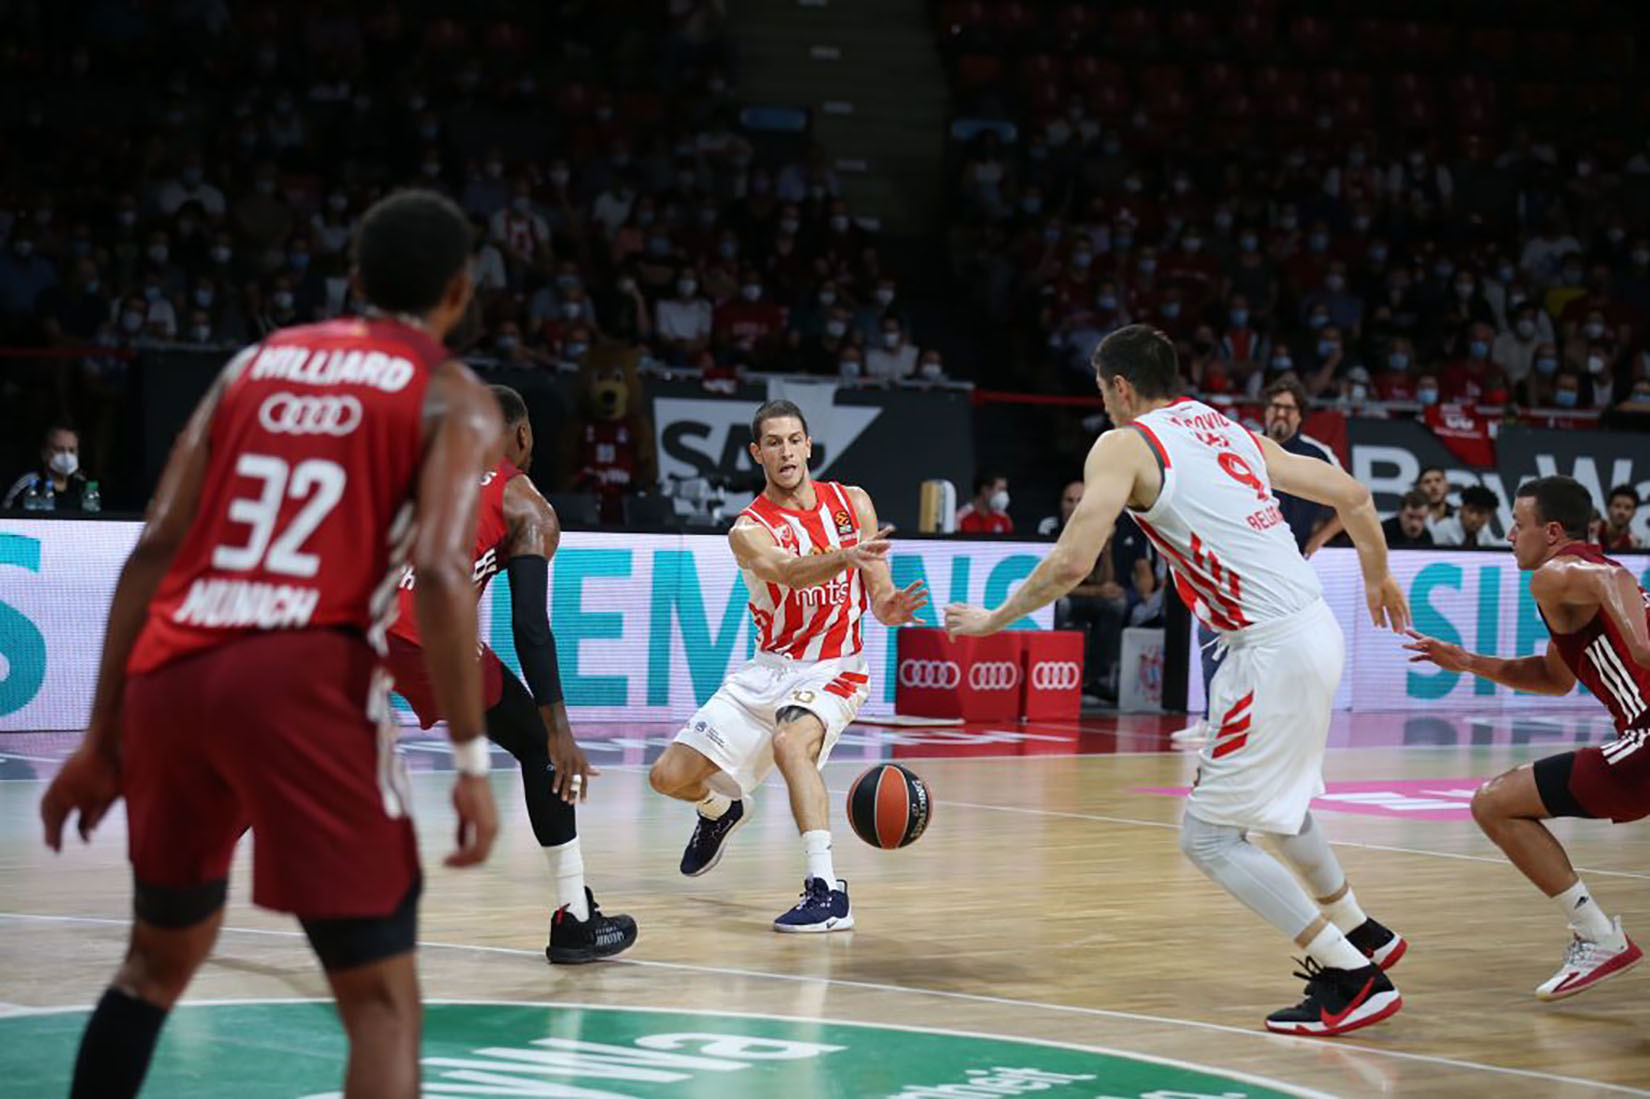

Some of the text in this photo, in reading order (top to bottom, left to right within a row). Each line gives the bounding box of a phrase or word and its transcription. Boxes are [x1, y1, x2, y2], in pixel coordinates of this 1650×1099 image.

[661, 420, 824, 493] SA
[1217, 452, 1269, 501] 9
[211, 453, 348, 578] 32
[172, 578, 321, 629] MUNICH
[795, 575, 850, 607] mts
[390, 545, 1048, 712] IEMNS
